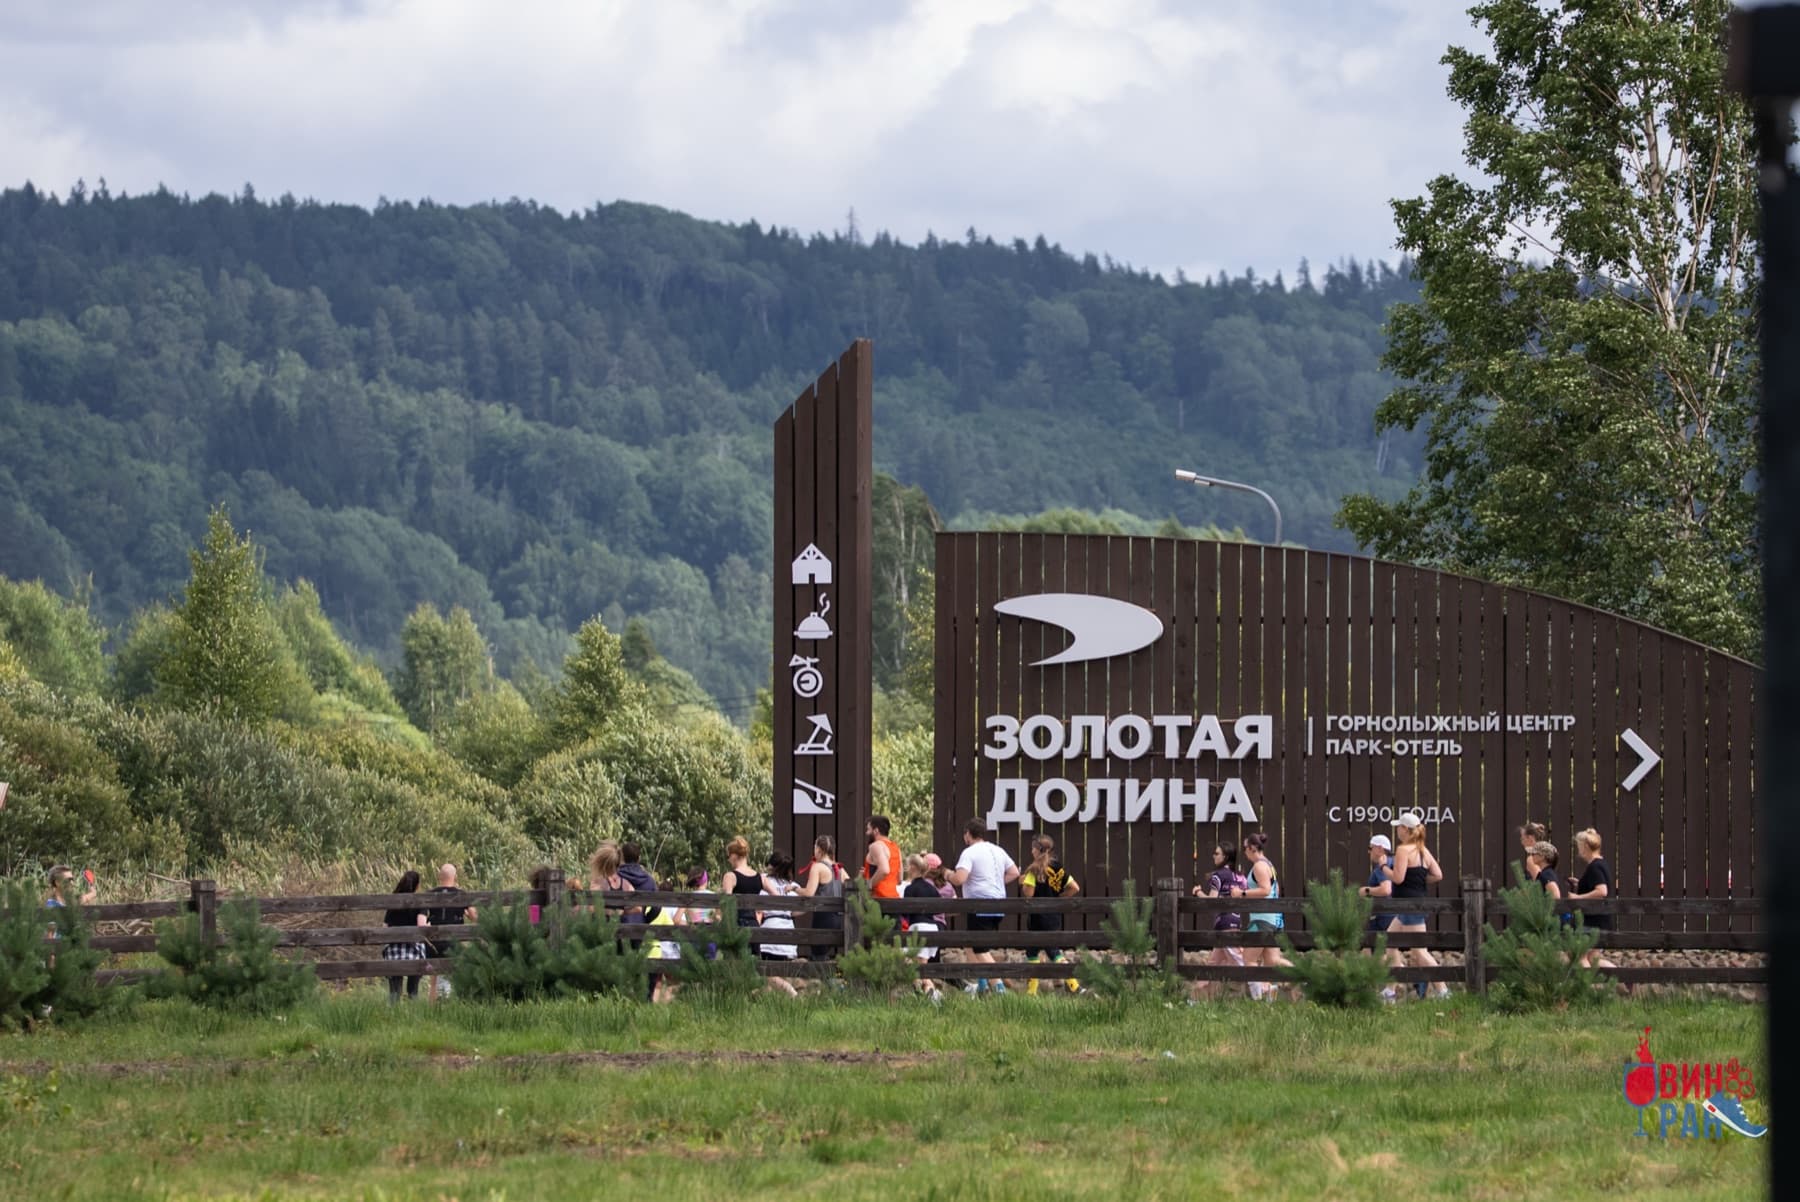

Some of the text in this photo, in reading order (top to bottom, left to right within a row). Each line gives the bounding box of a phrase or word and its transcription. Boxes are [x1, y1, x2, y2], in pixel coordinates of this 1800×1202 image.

[1325, 711, 1576, 734] ГОРНОЛЫЖНЫЙ ЦЕНТР
[984, 714, 1273, 760] ЗОЛОТАЯ
[1325, 738, 1463, 756] ПАРК-ОТЕЛЬ
[986, 777, 1258, 830] ДОЛИНА
[1328, 806, 1342, 823] С
[1346, 806, 1392, 823] 1990
